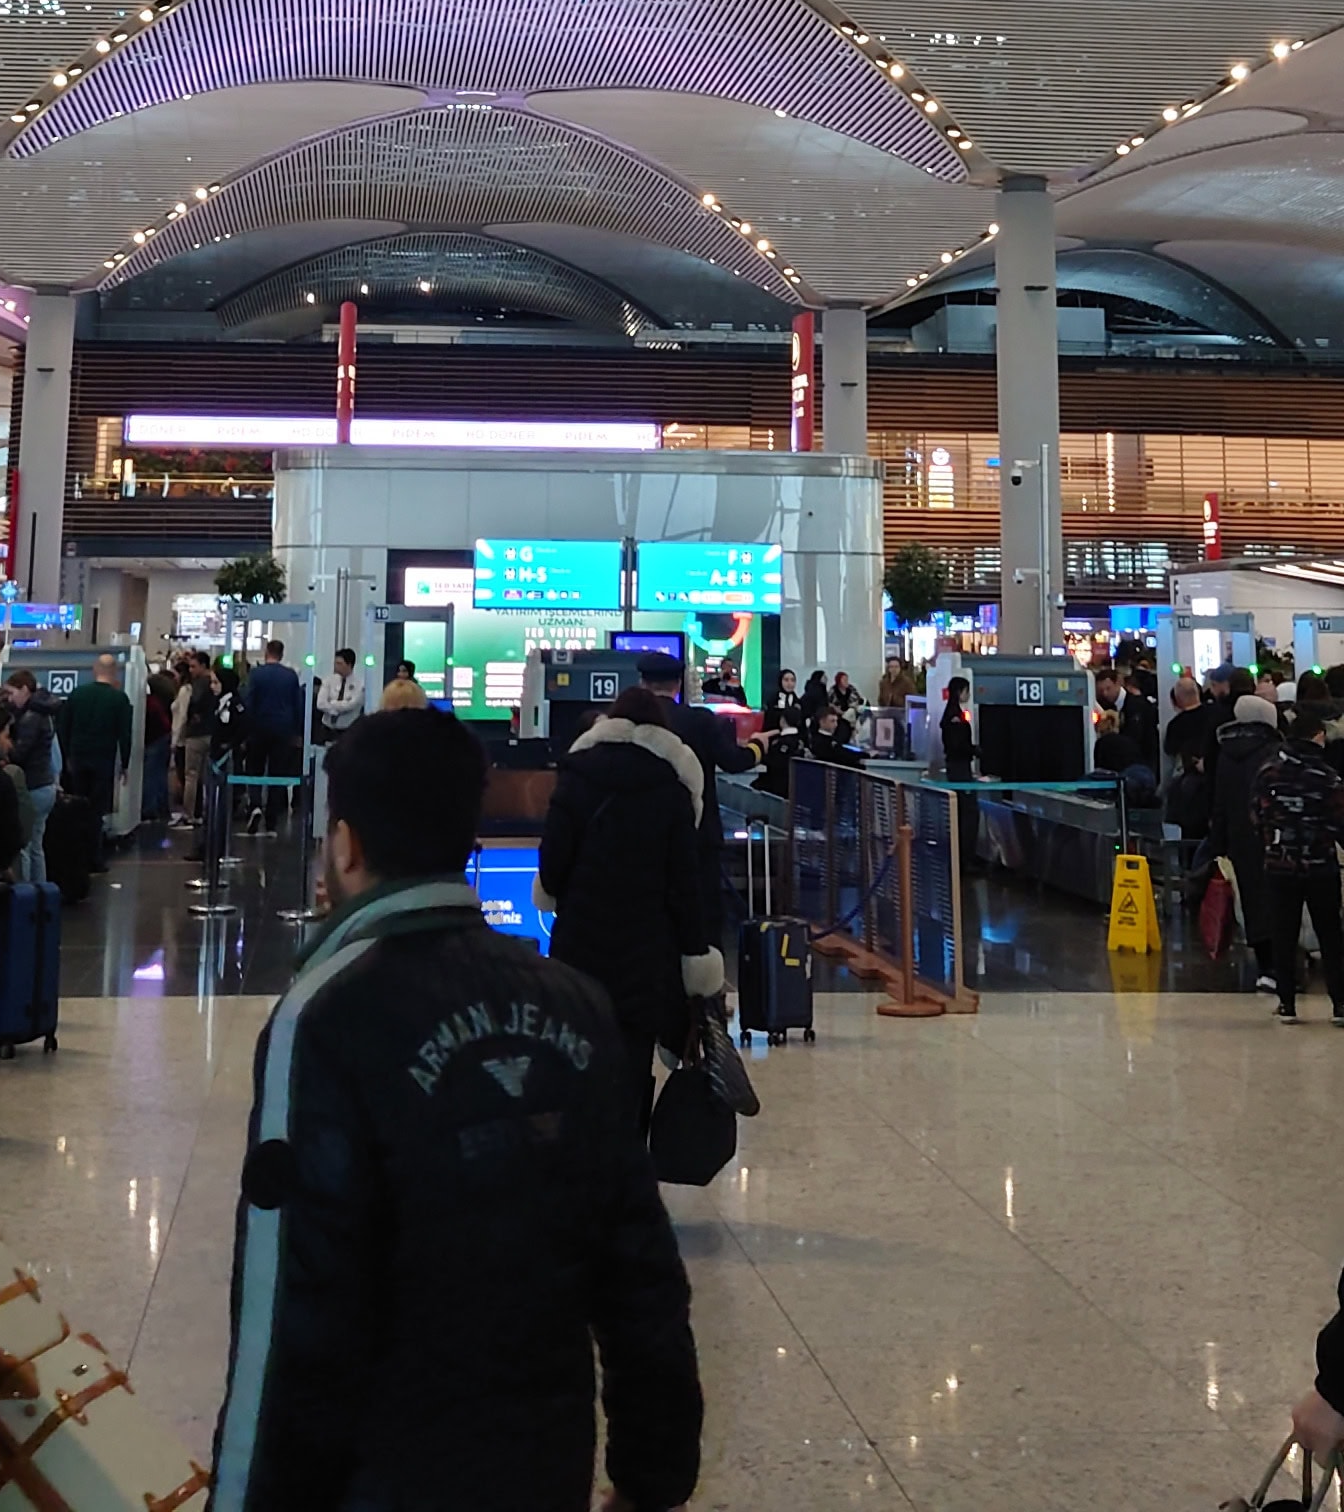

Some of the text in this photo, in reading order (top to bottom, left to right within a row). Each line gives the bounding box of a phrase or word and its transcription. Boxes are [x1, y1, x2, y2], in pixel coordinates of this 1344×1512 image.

[519, 546, 533, 562] G
[518, 566, 548, 583] H-S
[709, 569, 738, 586] A-E
[234, 606, 248, 618] 20
[376, 607, 389, 619] 19
[1318, 617, 1331, 630] 17
[52, 677, 74, 694] 20
[594, 680, 614, 695] 19
[1019, 683, 1041, 700] 18
[504, 1002, 593, 1071] JEANS
